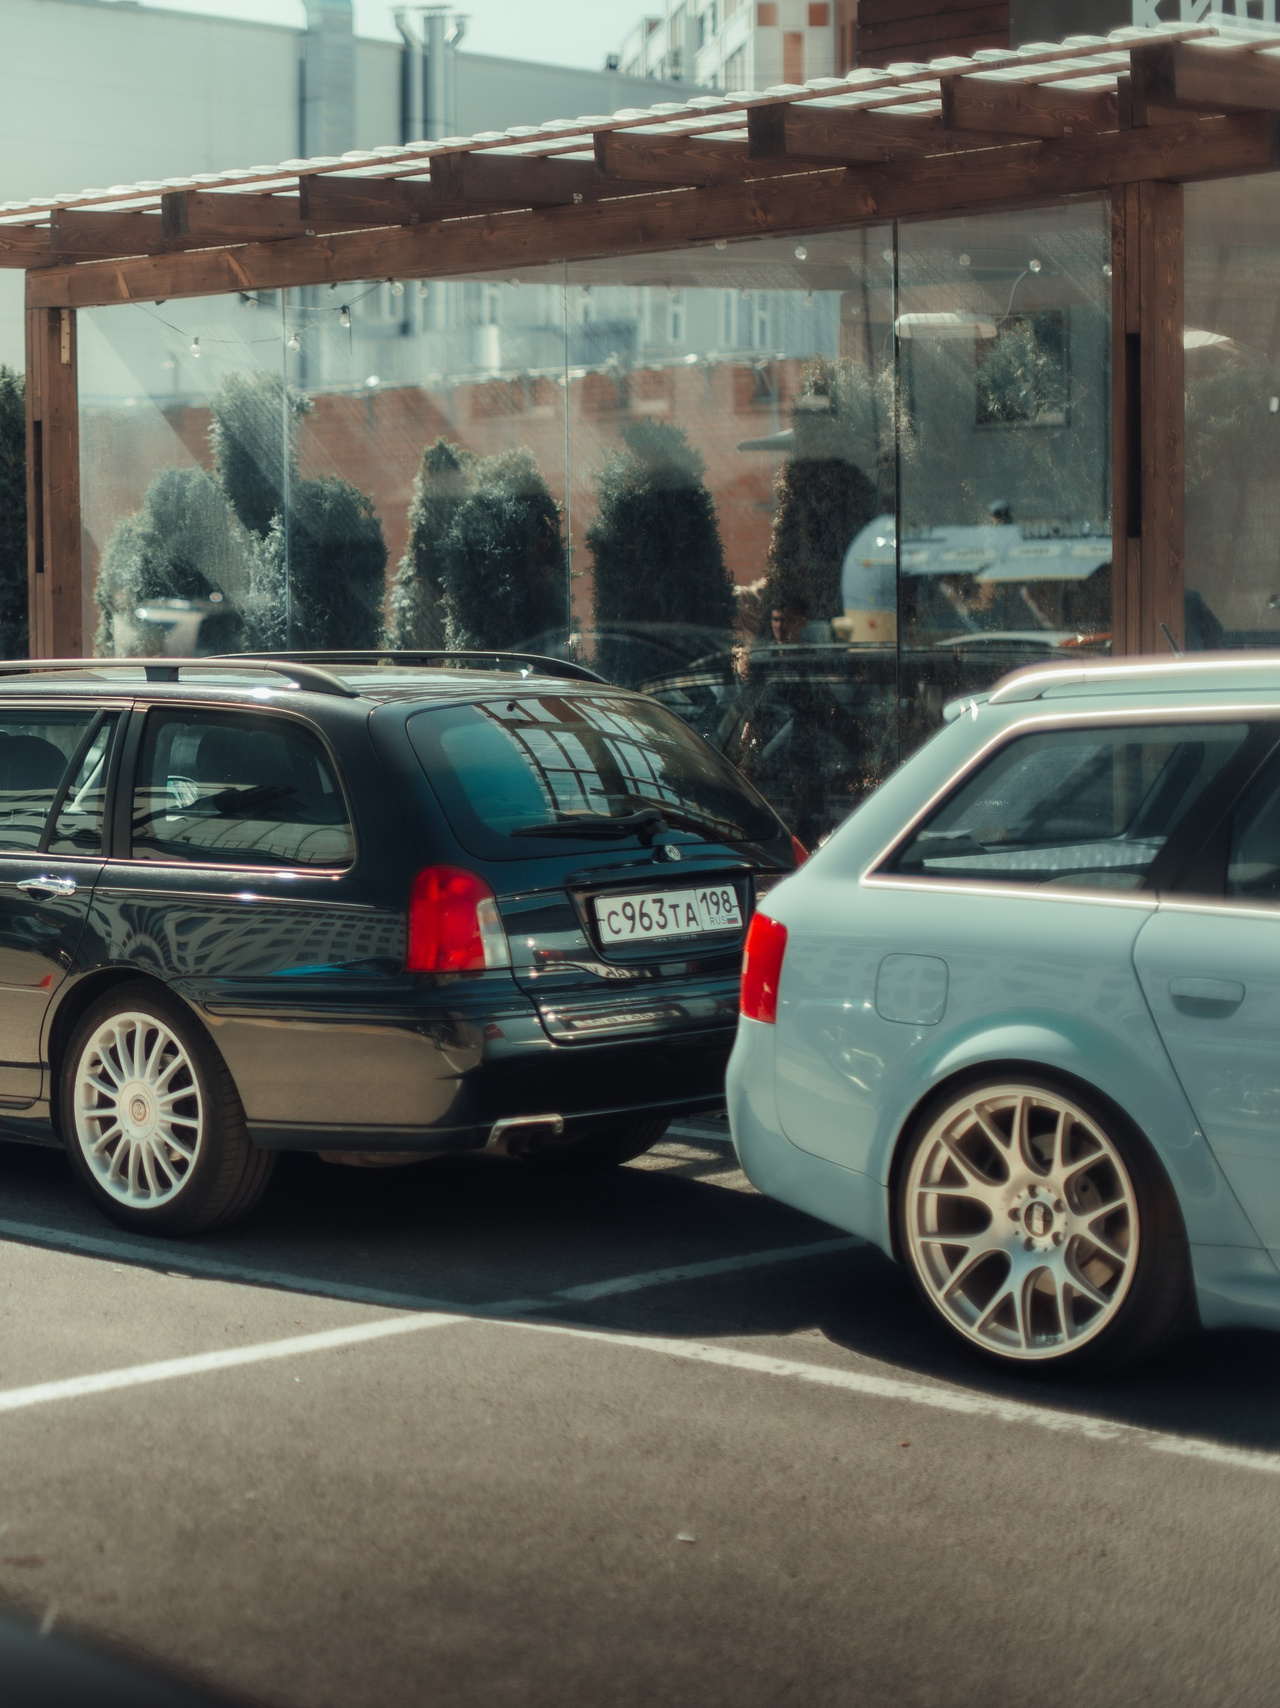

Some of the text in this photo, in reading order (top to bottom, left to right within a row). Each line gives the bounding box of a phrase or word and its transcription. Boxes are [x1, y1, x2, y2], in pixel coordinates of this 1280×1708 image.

[607, 890, 733, 935] С963ТА 198
[709, 916, 727, 926] RUS
